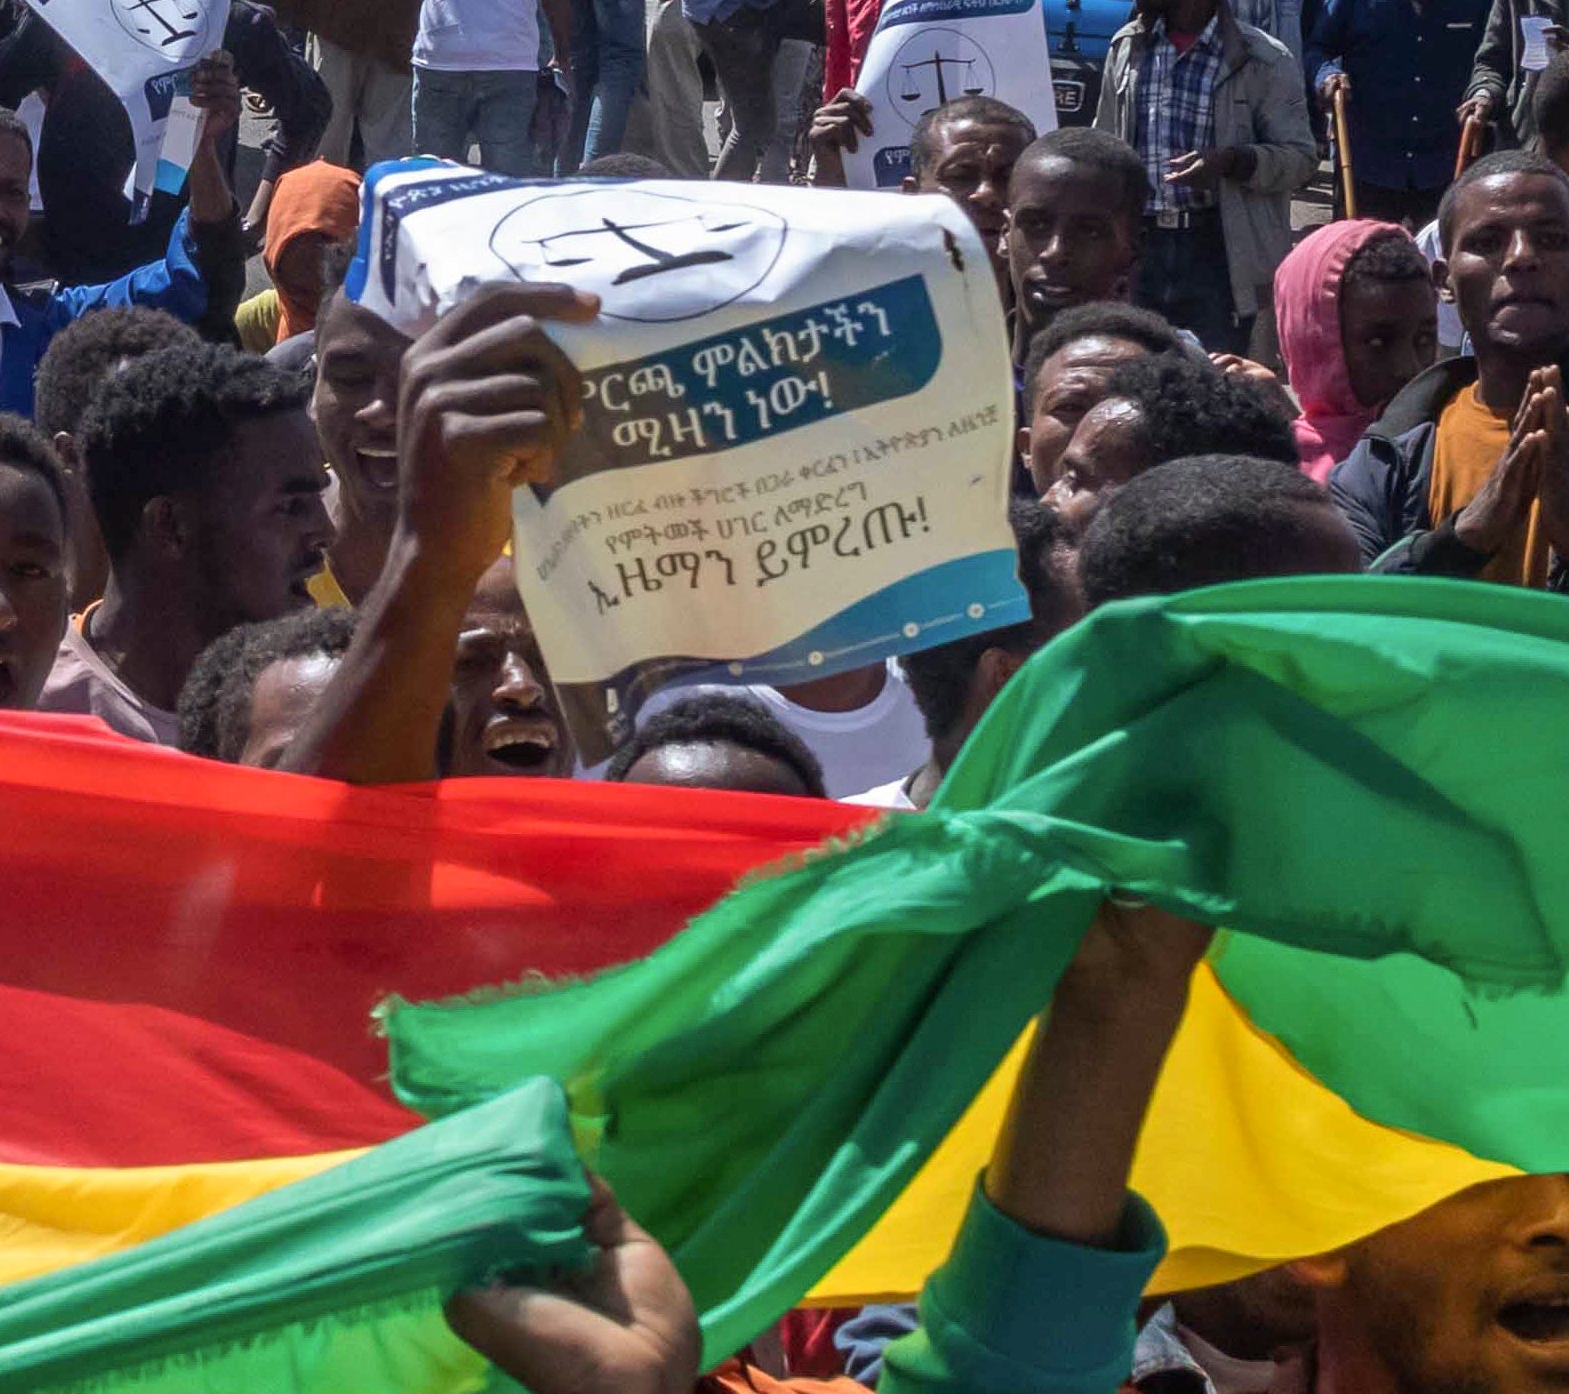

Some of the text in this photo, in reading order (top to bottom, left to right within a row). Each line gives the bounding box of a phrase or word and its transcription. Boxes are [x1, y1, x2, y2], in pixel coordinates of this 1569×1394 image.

[691, 301, 892, 388] ምልክታችን
[613, 371, 833, 457] ሚዛን ነው!
[716, 510, 767, 540] ሀገር
[775, 480, 867, 527] ለማድረግ
[587, 495, 930, 615] ኢዜማን ይምረጡ!
